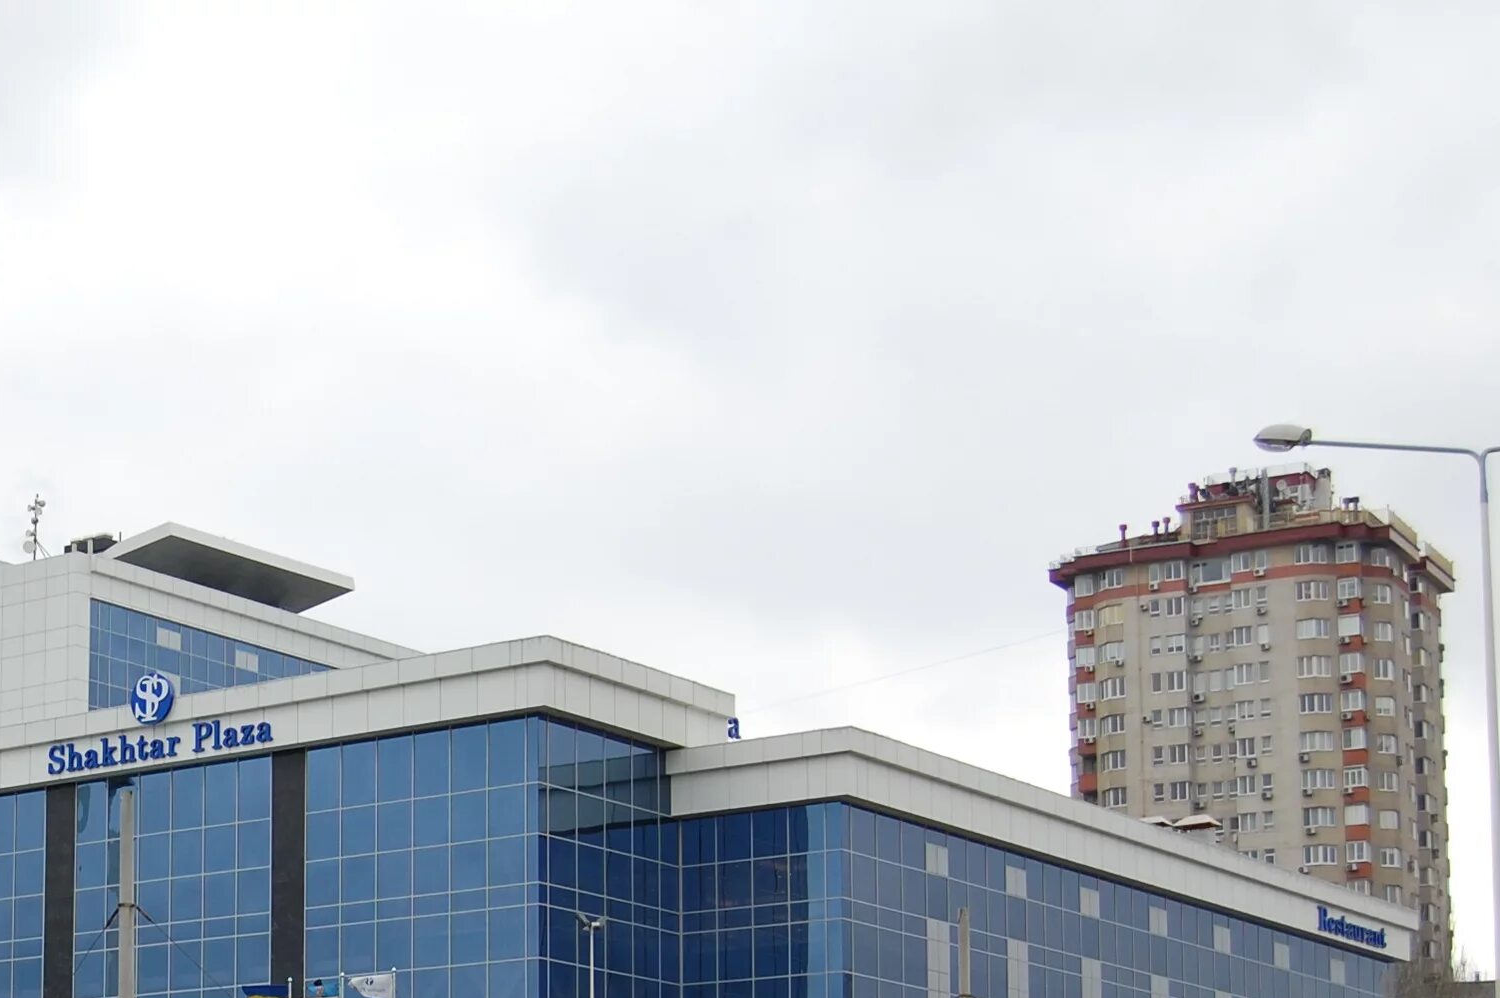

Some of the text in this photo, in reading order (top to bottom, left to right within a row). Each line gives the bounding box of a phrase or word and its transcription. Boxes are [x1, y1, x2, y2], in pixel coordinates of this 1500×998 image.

[47, 719, 274, 775] Shakhtar Plaza
[1316, 904, 1387, 949] Restaurant
